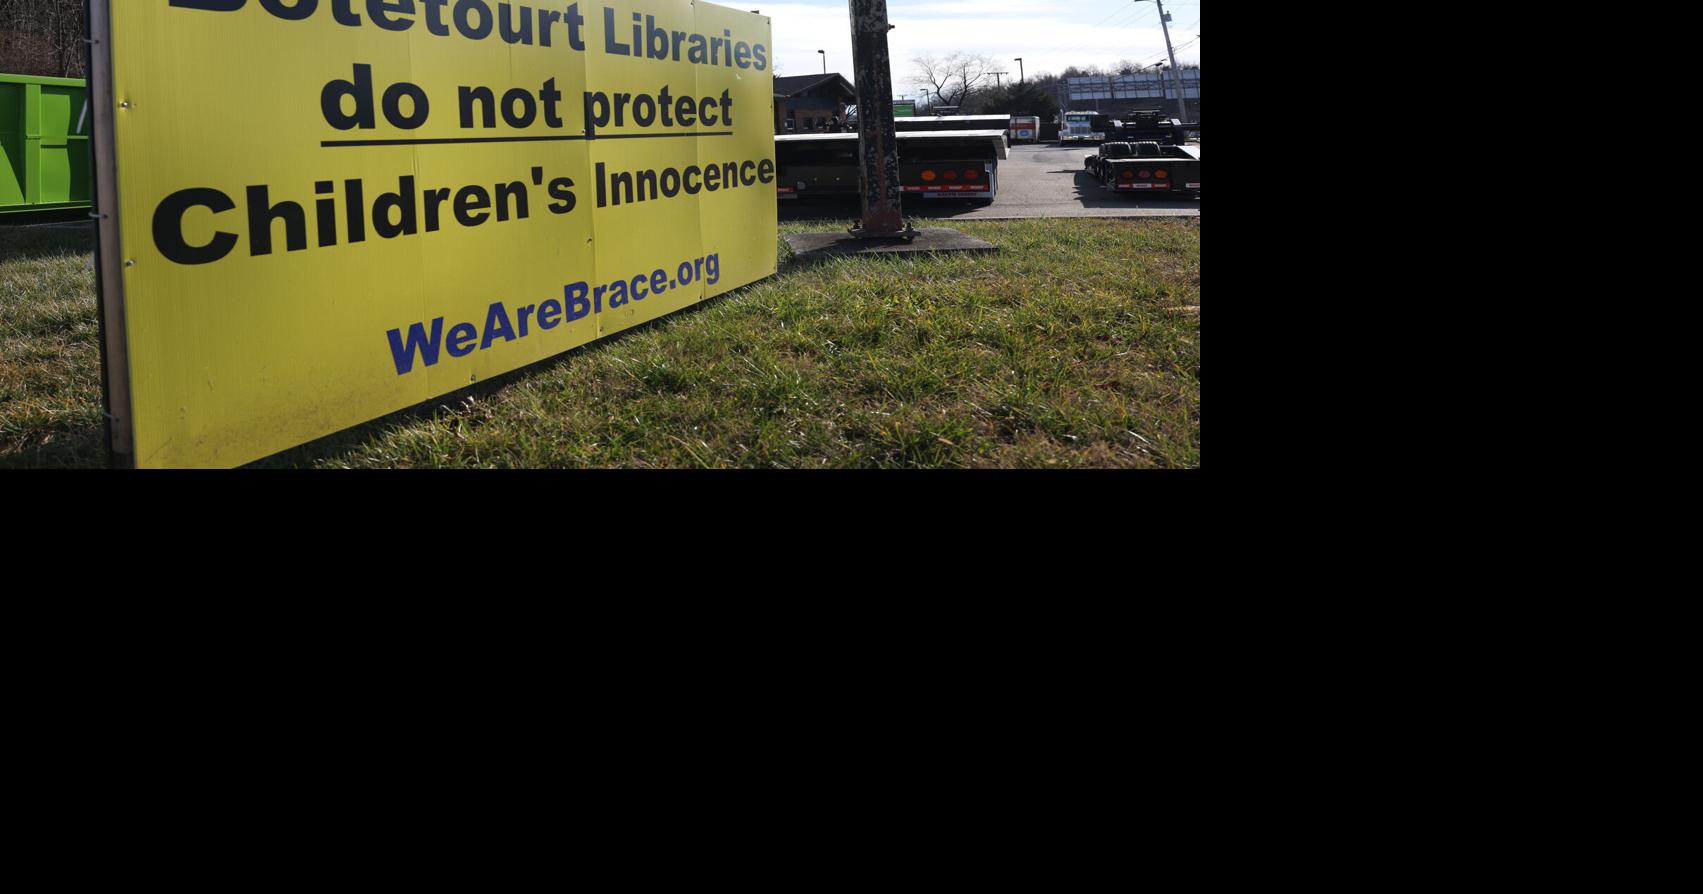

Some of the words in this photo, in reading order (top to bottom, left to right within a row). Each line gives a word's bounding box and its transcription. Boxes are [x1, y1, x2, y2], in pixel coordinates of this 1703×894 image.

[168, 0, 586, 51] etourt
[604, 7, 767, 71] Libraries
[320, 63, 430, 130] do
[458, 77, 564, 129] not
[583, 85, 733, 140] protect
[151, 165, 577, 266] Children's
[595, 157, 776, 209] Innocence
[386, 252, 721, 376] WeAreBrace.org
